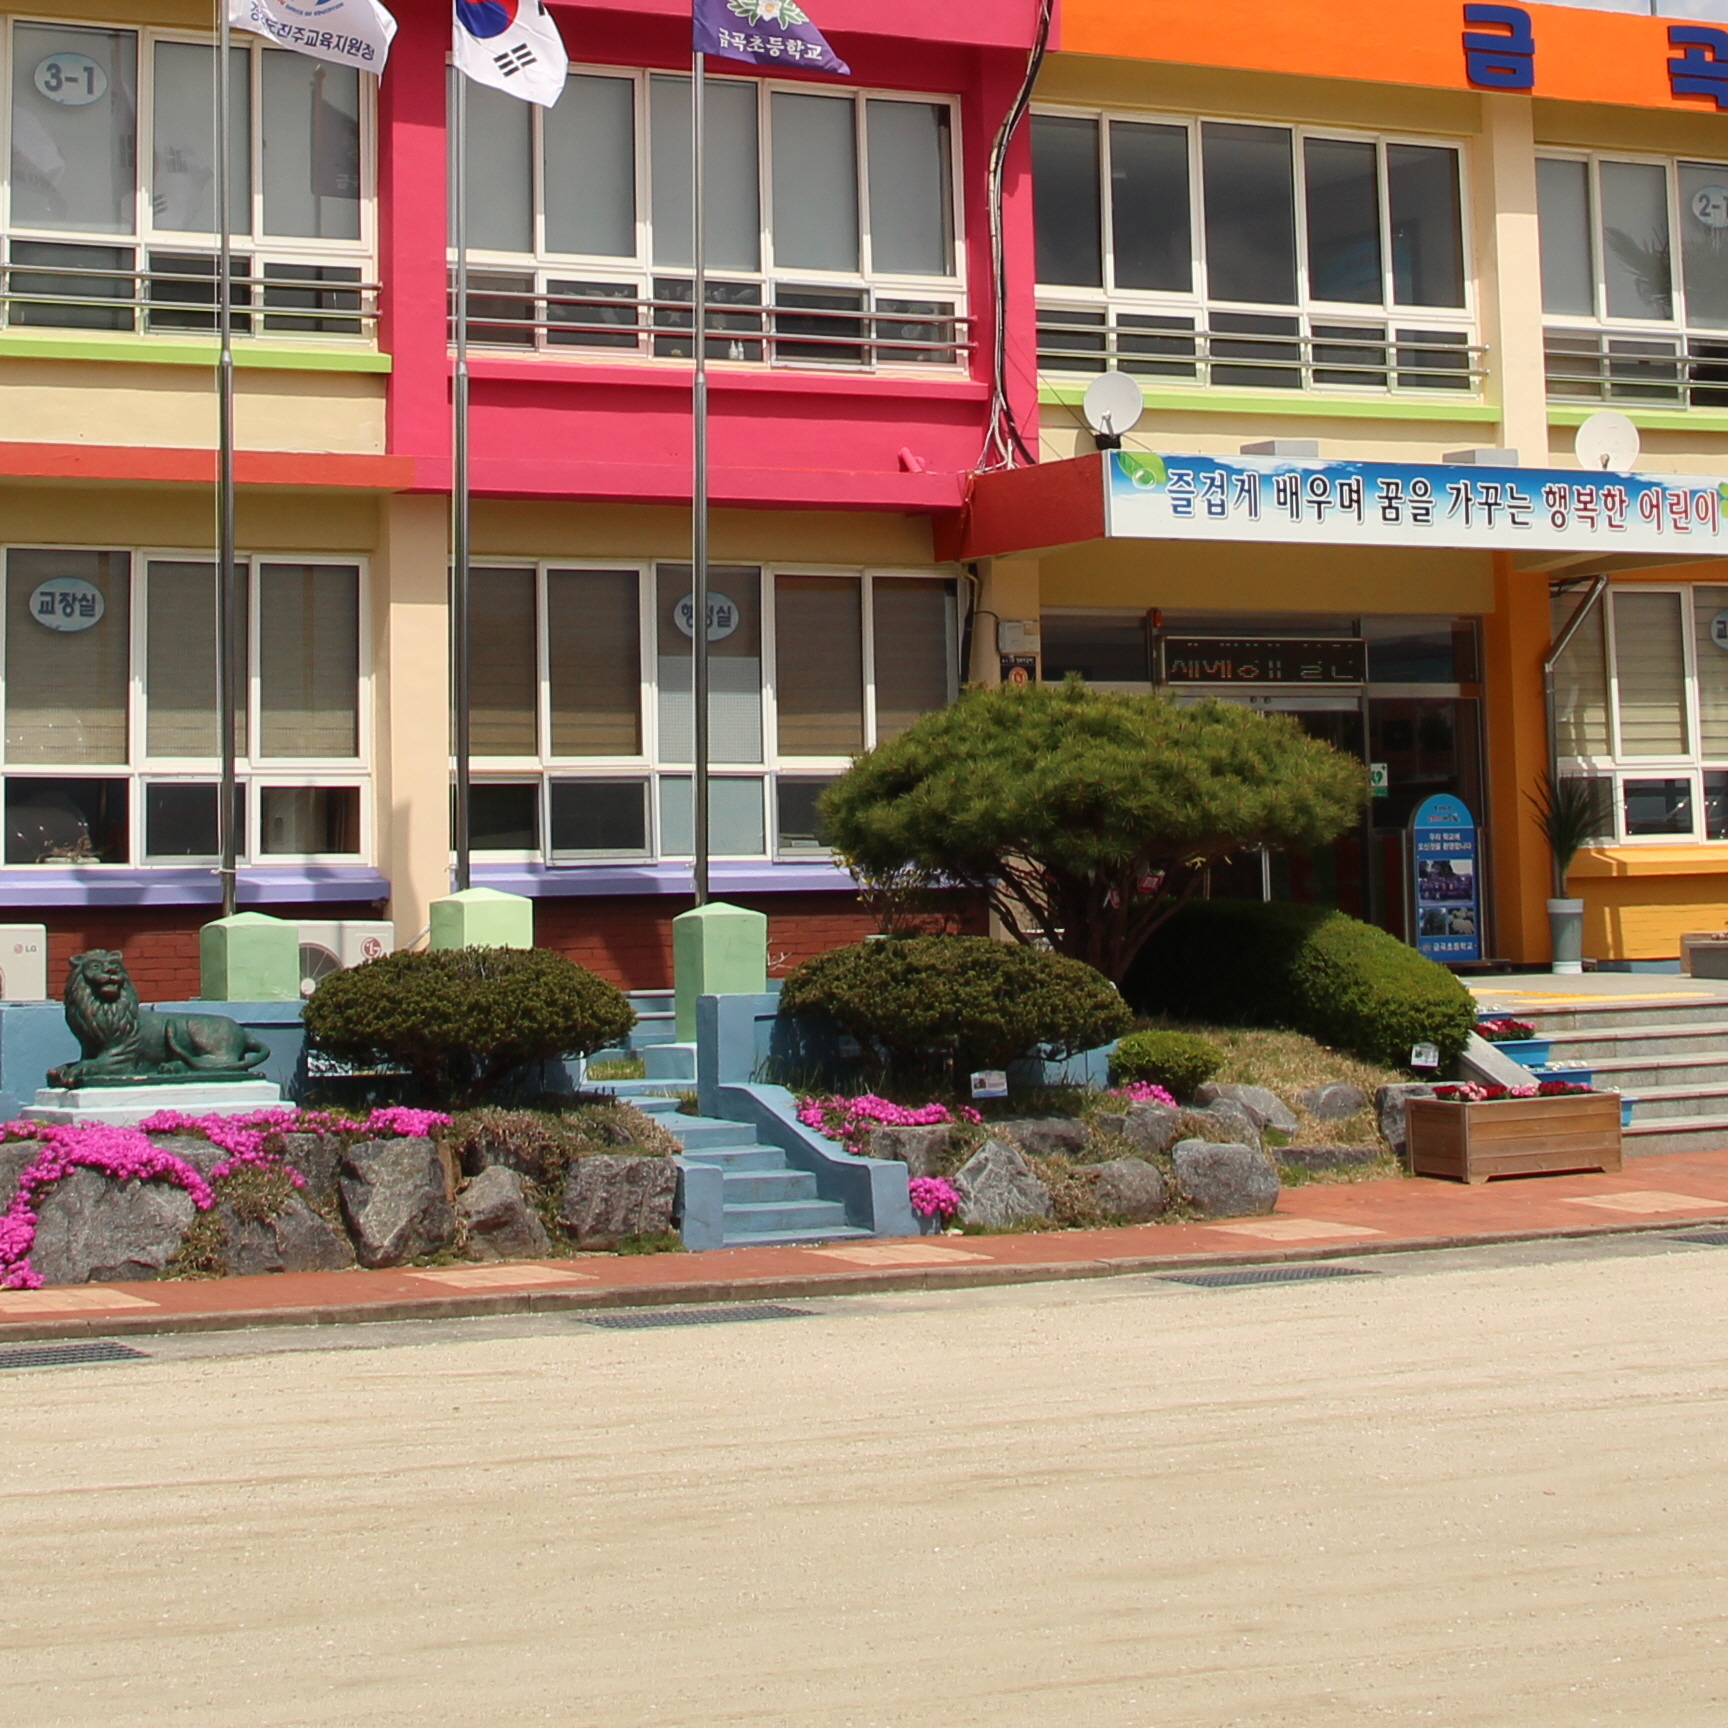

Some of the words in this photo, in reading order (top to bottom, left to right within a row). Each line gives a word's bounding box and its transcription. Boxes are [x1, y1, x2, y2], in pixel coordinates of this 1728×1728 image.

[719, 27, 823, 61] 금곡초등학교
[44, 62, 94, 95] 3-1
[1166, 469, 1261, 519] 즐겁게
[1272, 474, 1364, 523] 배우며
[1376, 478, 1435, 525] 꿈을
[1446, 479, 1533, 528] 가꾸는
[1542, 482, 1627, 531] 행복한
[1638, 487, 1719, 535] 어린이
[38, 591, 96, 618] 교장실
[25, 945, 37, 953] LG
